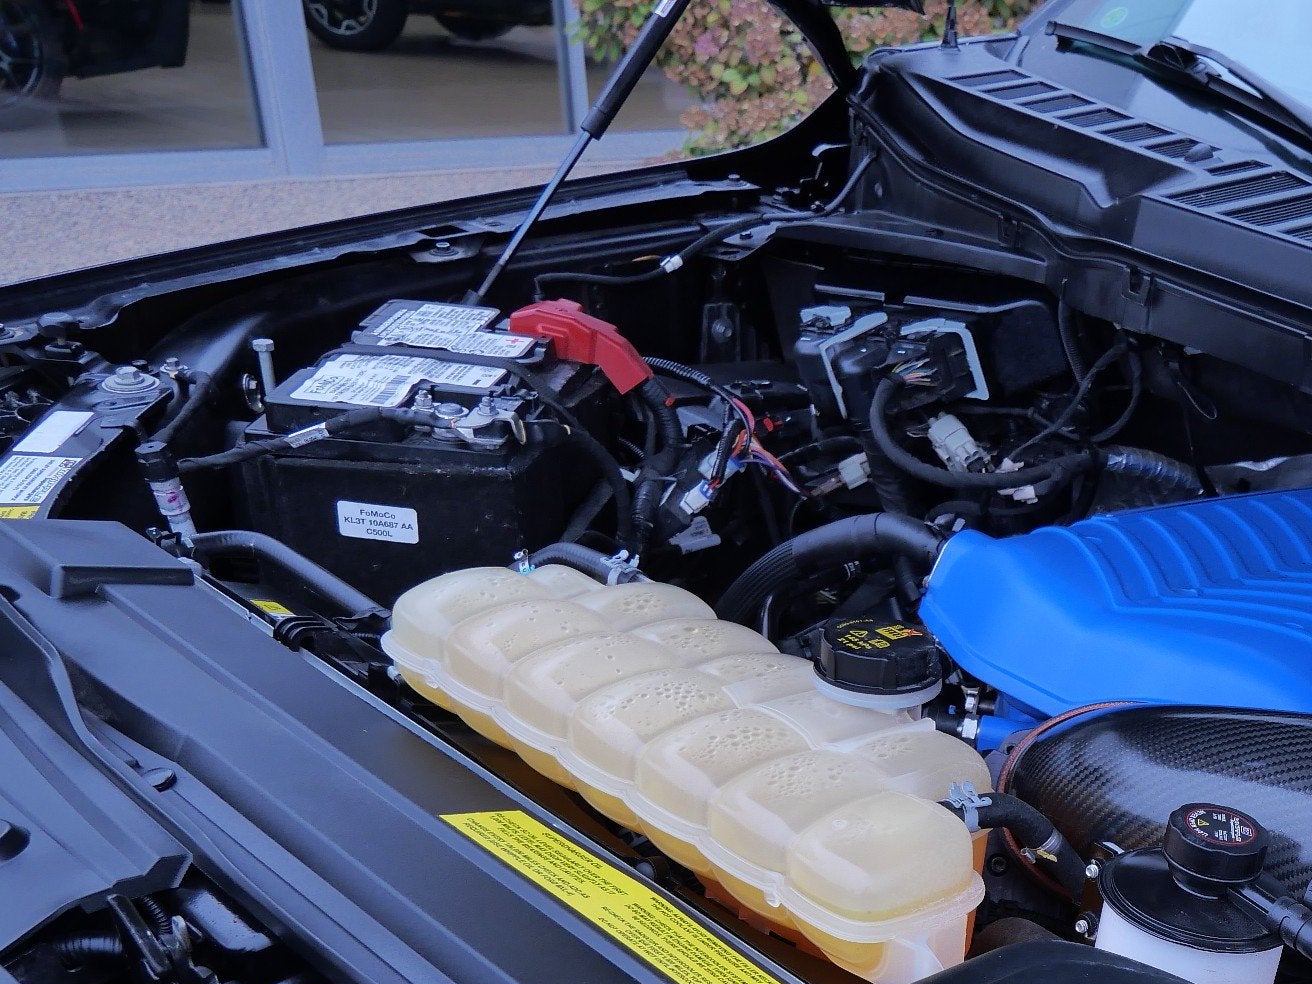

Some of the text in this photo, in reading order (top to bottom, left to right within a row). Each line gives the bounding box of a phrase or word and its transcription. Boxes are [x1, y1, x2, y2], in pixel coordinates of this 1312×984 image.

[360, 509, 396, 520] FoMoCo
[344, 516, 414, 531] KL3T 10A687 AA
[366, 528, 393, 537] C500L
